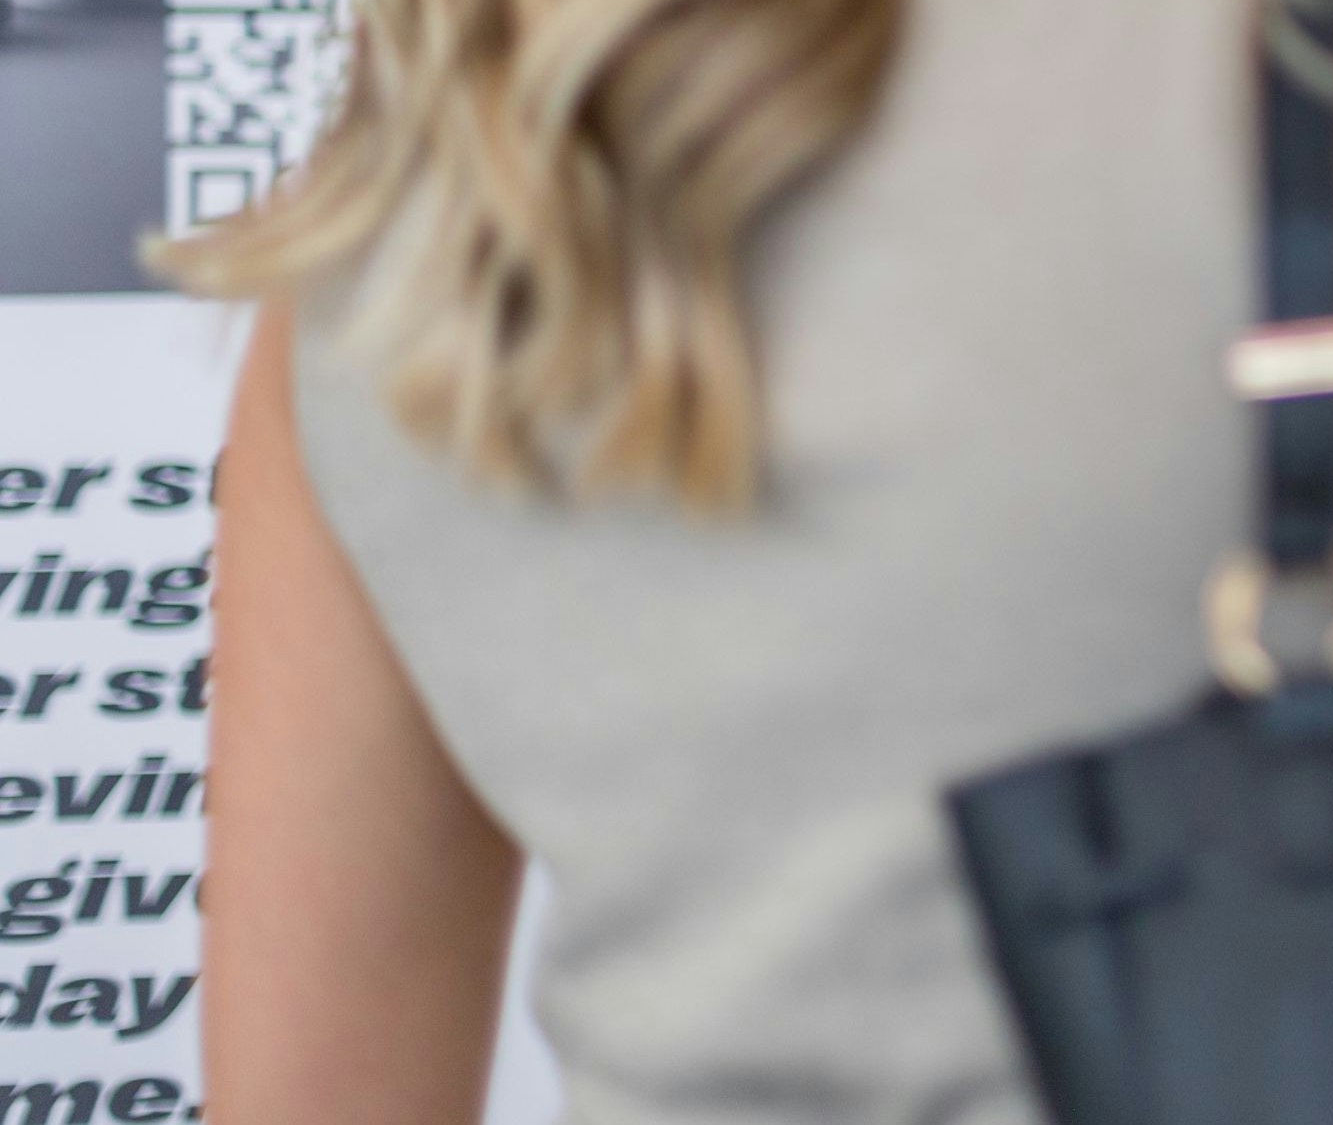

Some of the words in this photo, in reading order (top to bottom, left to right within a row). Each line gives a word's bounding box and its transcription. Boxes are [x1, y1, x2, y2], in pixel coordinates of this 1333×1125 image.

[126, 462, 218, 509] s
[0, 859, 206, 940] giv
[0, 963, 200, 1039] day
